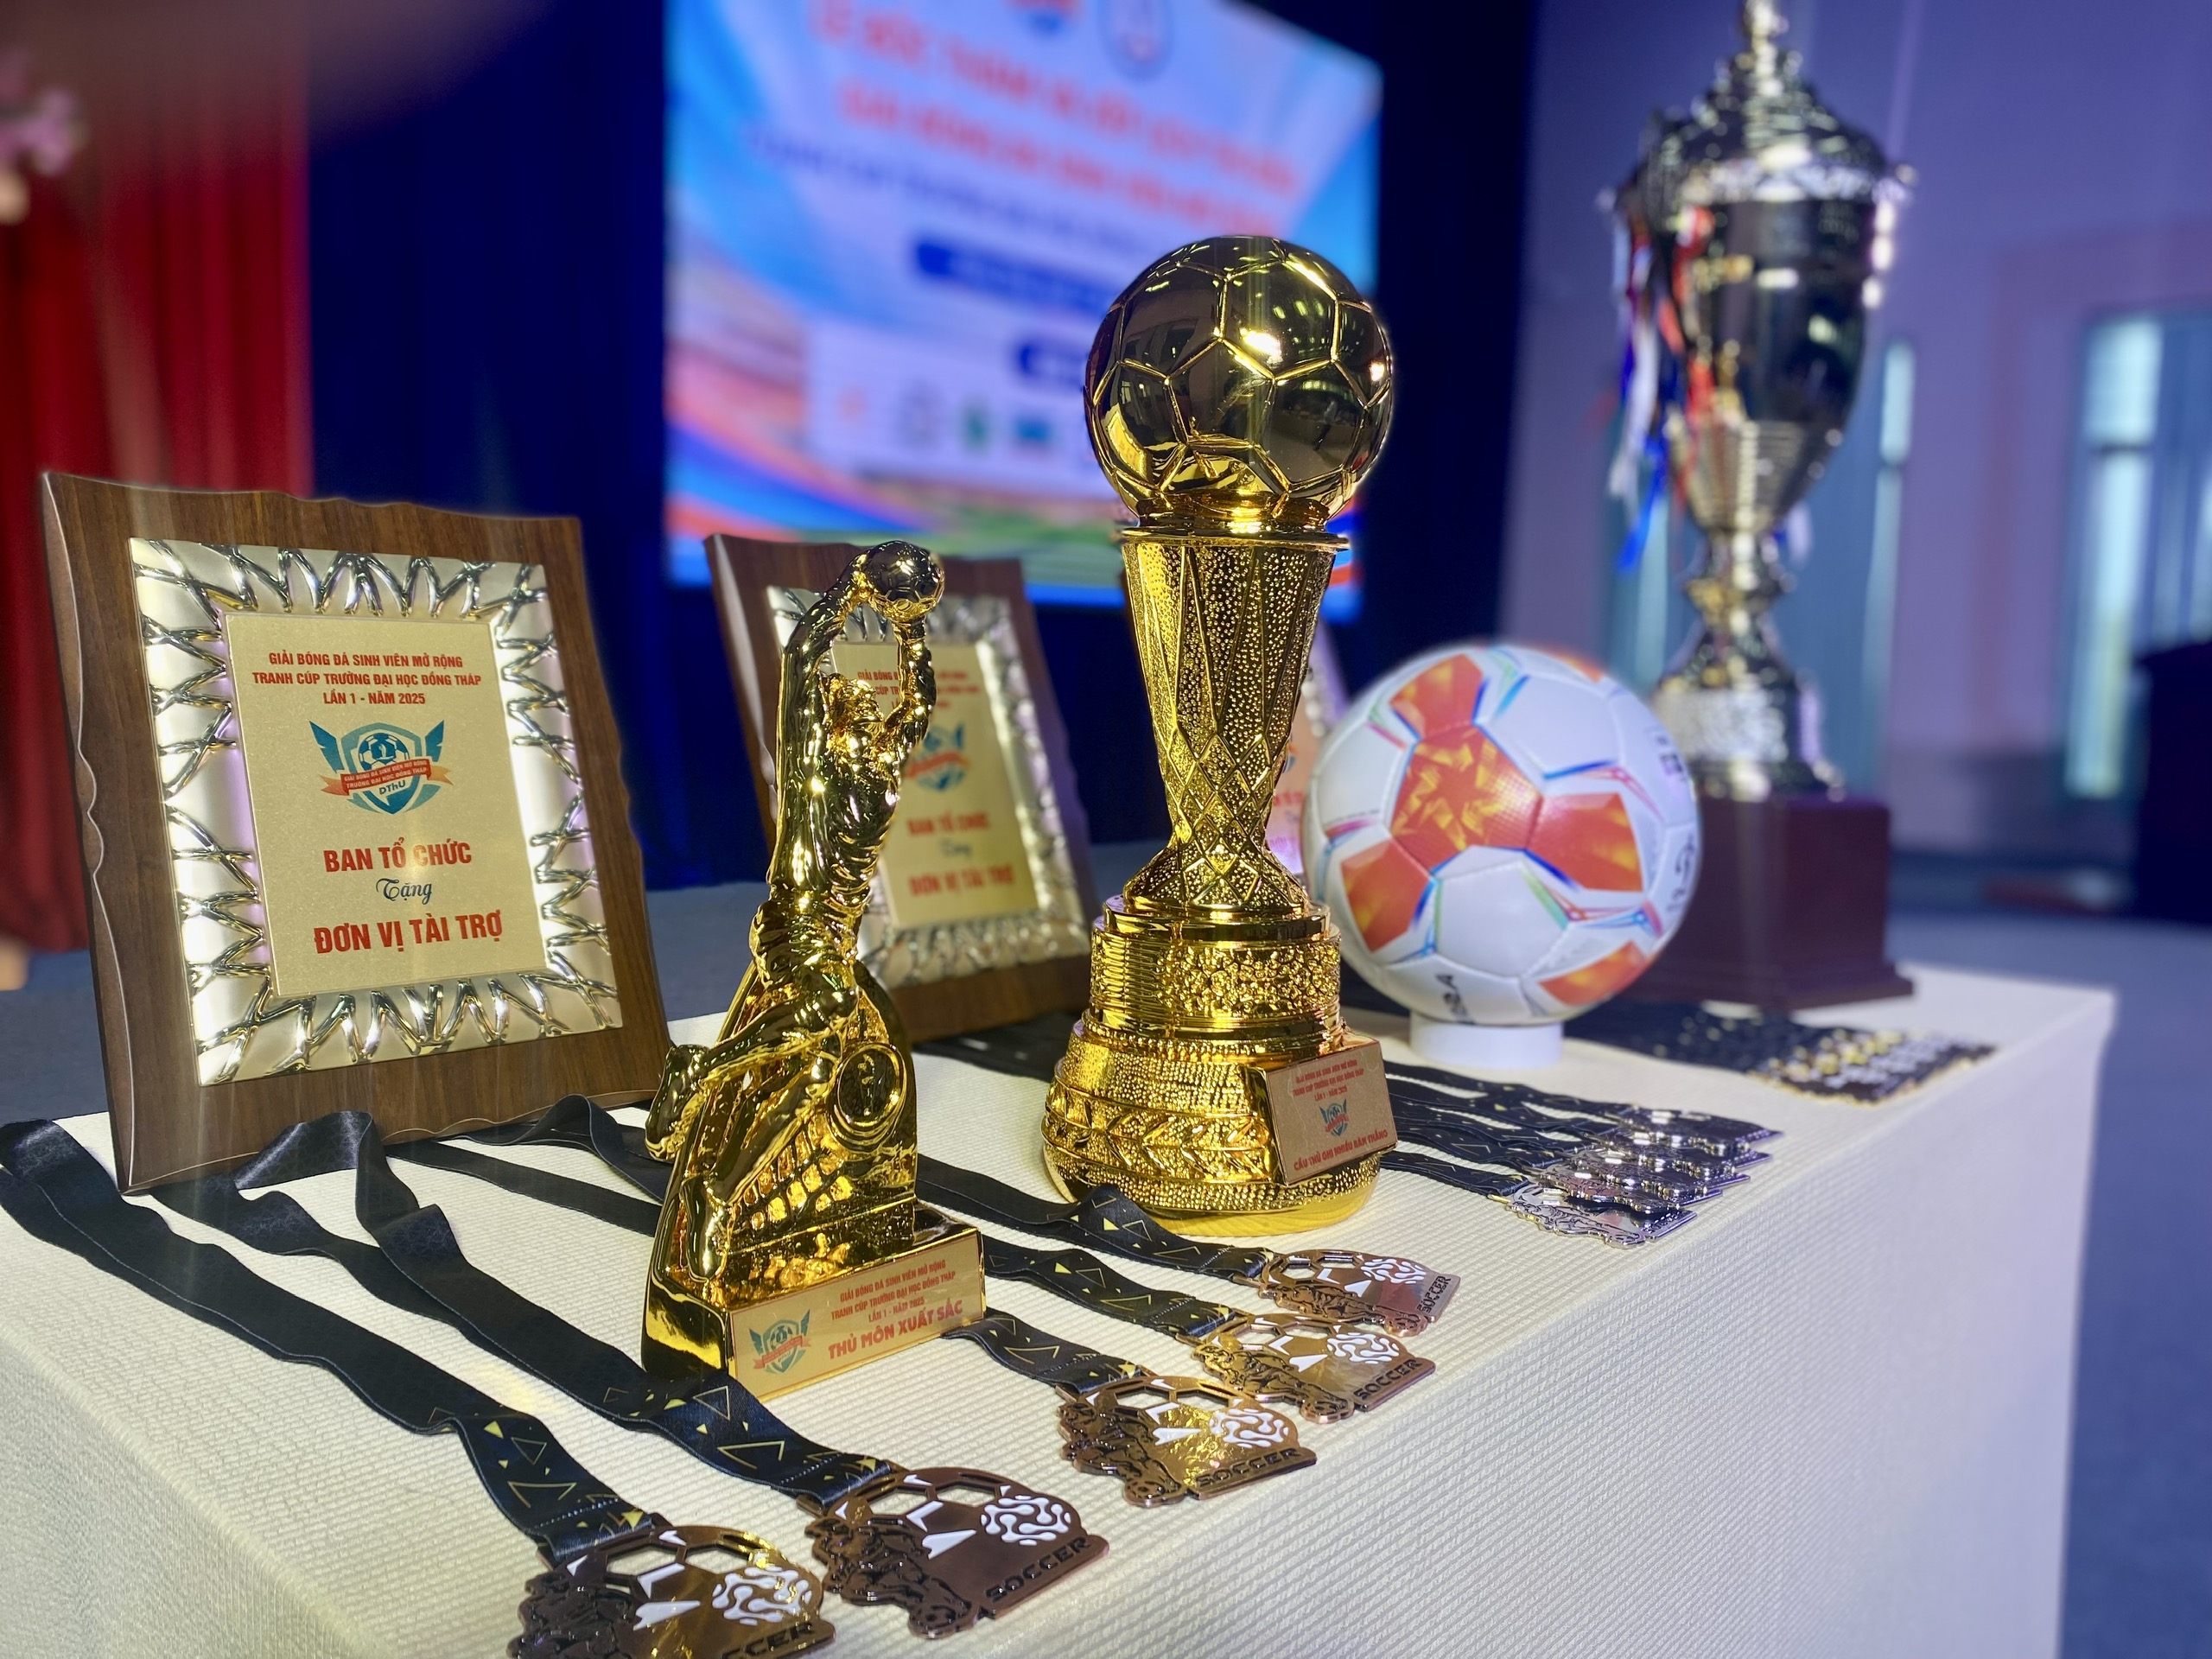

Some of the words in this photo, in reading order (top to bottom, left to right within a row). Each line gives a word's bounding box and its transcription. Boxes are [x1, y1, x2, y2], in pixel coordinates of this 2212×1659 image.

[269, 650, 294, 665] GIẢI
[297, 652, 330, 666] BÓNG
[334, 652, 349, 666] ĐÁ
[353, 654, 380, 666] SINH
[383, 653, 409, 667] VIÊN
[412, 652, 430, 667] MỞ
[434, 655, 462, 670] RỘNG
[252, 671, 293, 684] TRANH
[296, 671, 321, 684] CÚP
[323, 670, 370, 684] TRƯỜNG
[373, 674, 392, 688] ĐẠI
[397, 675, 418, 688] HỌC
[454, 671, 481, 685] THÁP
[323, 689, 346, 704] LẦN
[350, 693, 356, 703] 1
[368, 690, 395, 704] NĂM
[398, 693, 426, 704] 2025
[379, 779, 405, 795] DThU
[323, 848, 371, 873] BAN
[378, 836, 408, 870] TỔ
[413, 838, 473, 866] CHỨC
[376, 877, 433, 905] Tặng
[314, 922, 372, 954] ĐƠN
[377, 919, 404, 952] VỊ
[409, 913, 449, 944] TÀI
[455, 909, 503, 943] TRỢ
[885, 1274, 900, 1287] SINH
[1416, 1276, 1451, 1313] SOCCER
[828, 1332, 857, 1359] THỦ
[861, 1324, 894, 1348] MÔN
[899, 1308, 934, 1335] XUẤT
[937, 1297, 963, 1321] SẮC
[831, 1306, 853, 1320] TRANH
[1353, 1359, 1422, 1400] SOCCER
[1196, 1448, 1301, 1487] SOCCER
[985, 1536, 1092, 1602] SOCCER
[721, 1621, 816, 1659] CCER
